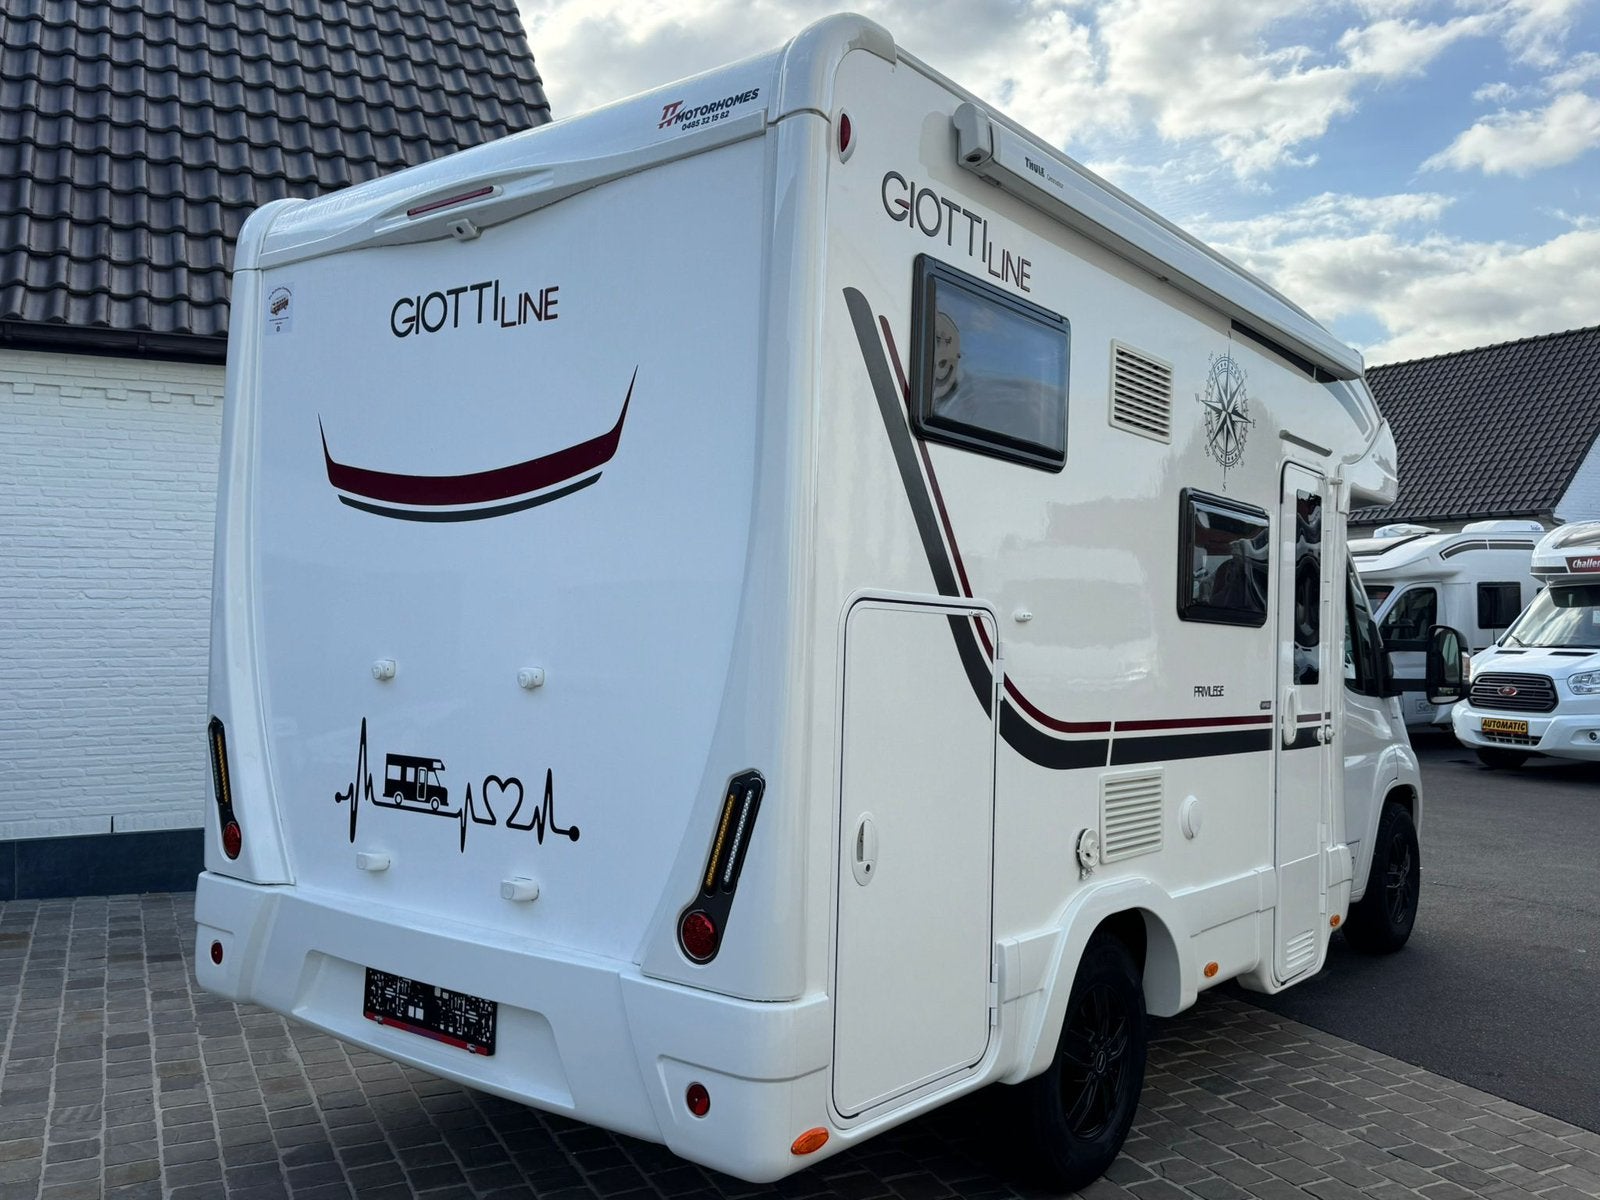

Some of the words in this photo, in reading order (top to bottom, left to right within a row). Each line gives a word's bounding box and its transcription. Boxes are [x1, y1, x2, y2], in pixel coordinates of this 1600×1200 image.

[674, 88, 760, 124] MOTORHOMES
[681, 119, 700, 131] 0485
[701, 117, 710, 125] 32
[711, 114, 719, 122] 15
[719, 110, 730, 119] 82
[1025, 156, 1045, 178] THULE
[1482, 719, 1526, 731] AUTOMATIC
